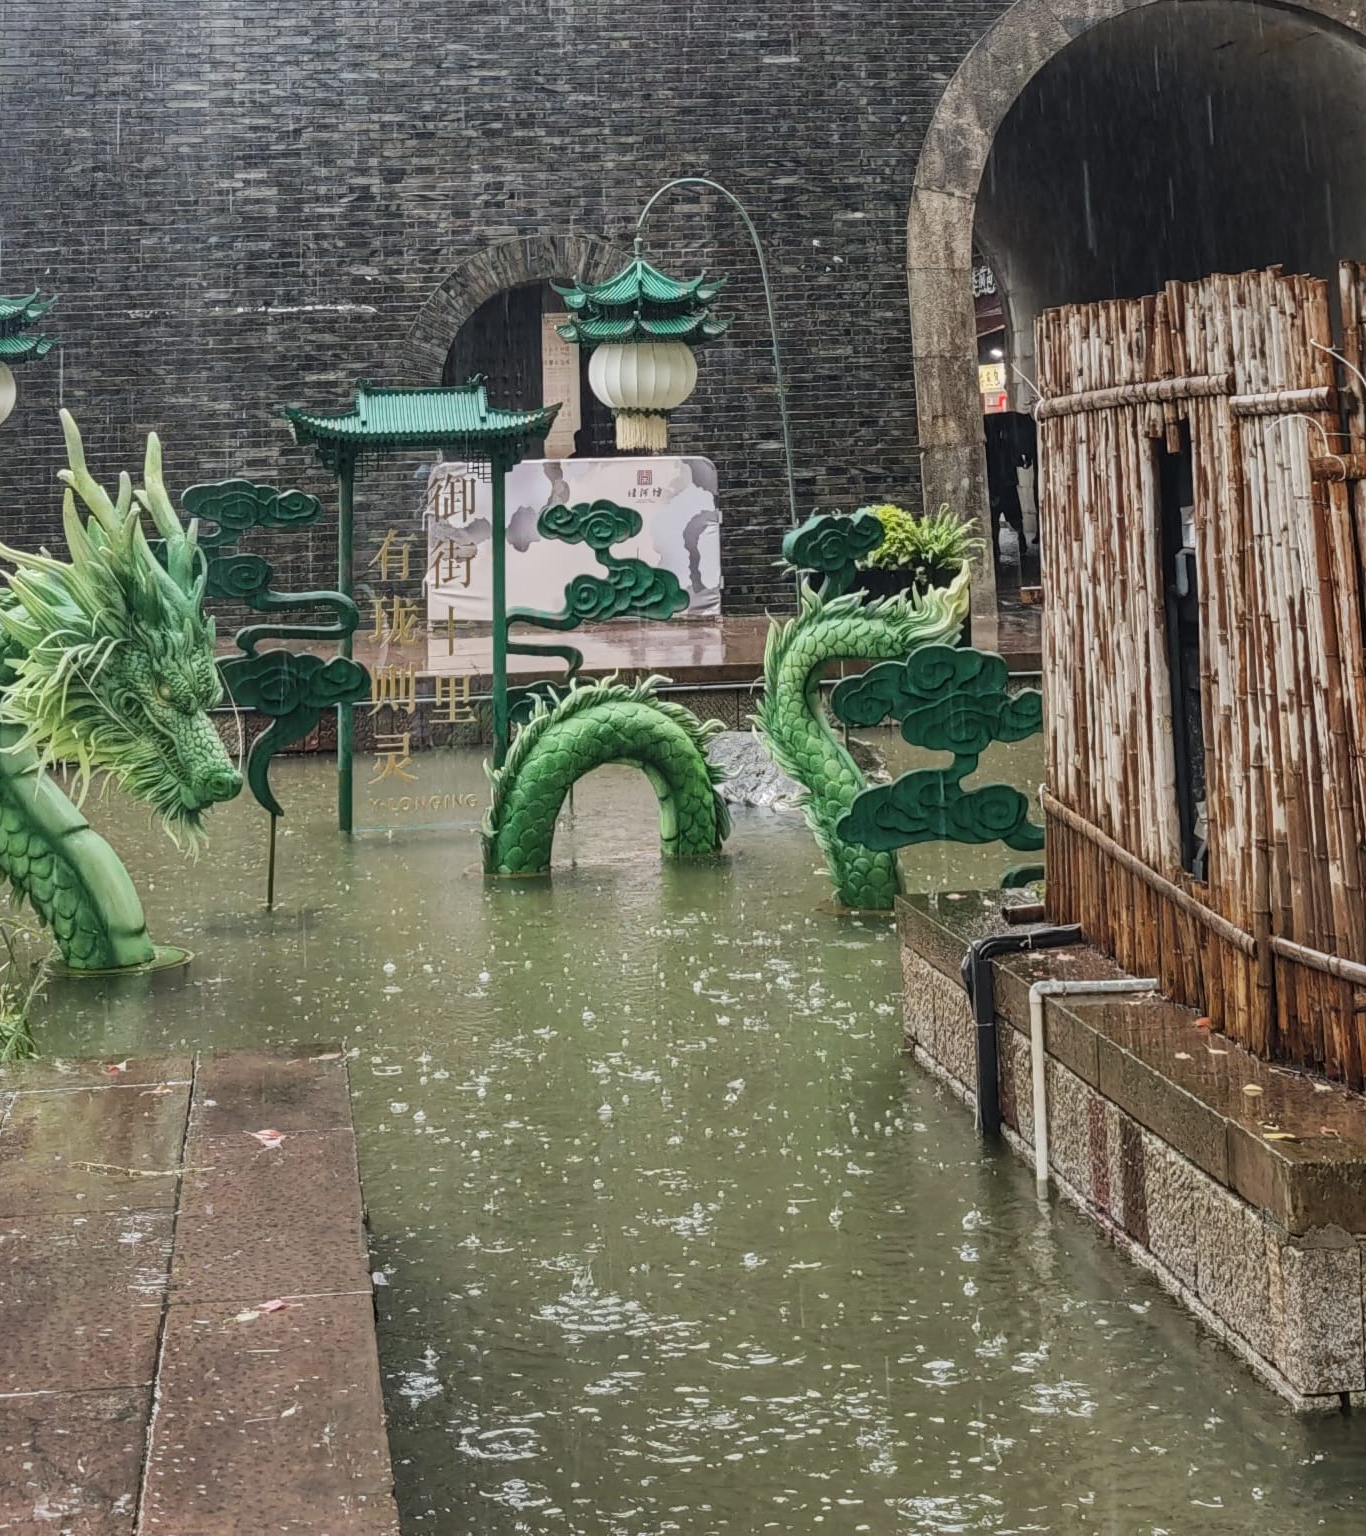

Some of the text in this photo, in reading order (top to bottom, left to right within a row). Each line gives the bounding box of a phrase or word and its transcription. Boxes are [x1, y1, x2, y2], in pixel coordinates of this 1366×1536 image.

[367, 528, 420, 784] 有珑则灵
[428, 473, 477, 724] 御街十里
